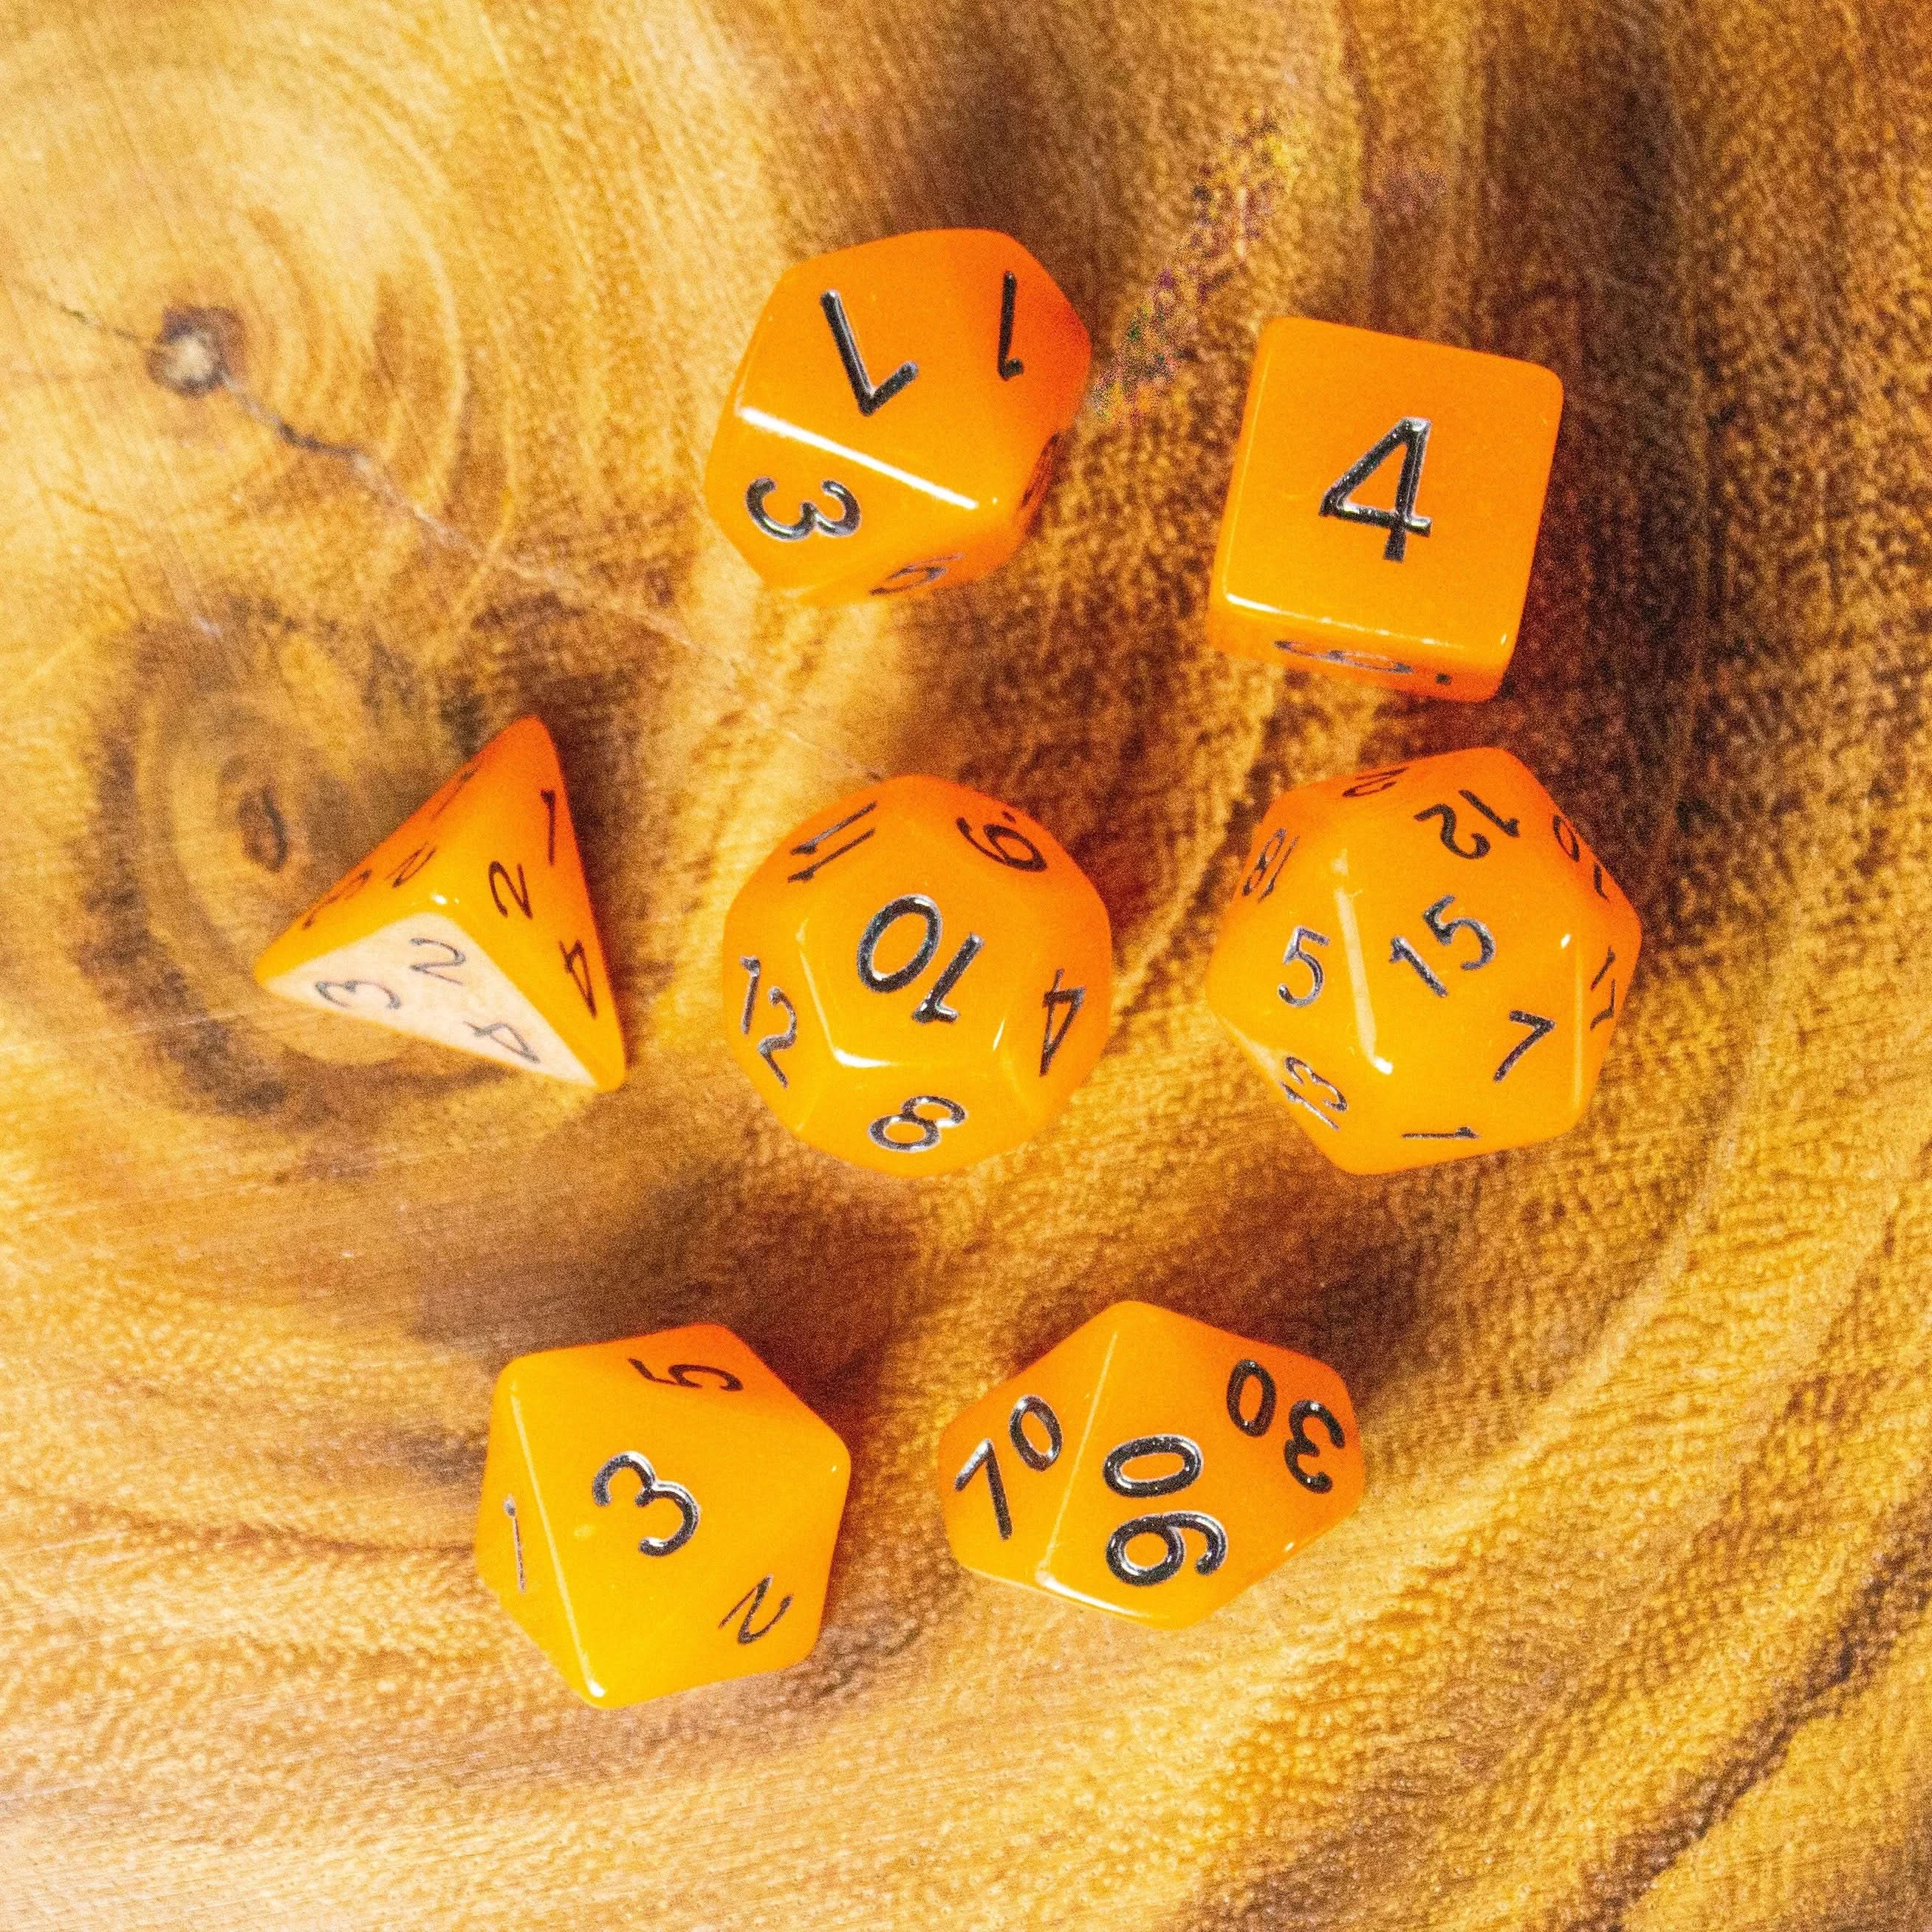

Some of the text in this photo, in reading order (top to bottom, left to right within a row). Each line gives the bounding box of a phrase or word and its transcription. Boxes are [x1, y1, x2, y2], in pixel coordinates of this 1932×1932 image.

[820, 289, 919, 417] 7
[998, 270, 1024, 381] 1
[744, 476, 860, 541] 3
[1319, 417, 1433, 563] 4
[540, 789, 557, 866] 1
[787, 801, 877, 883] 11
[1414, 788, 1521, 861] 12
[488, 860, 533, 921] 2
[409, 936, 467, 987] 2
[557, 939, 597, 1020] 4
[856, 892, 984, 1024] 10
[1278, 925, 1330, 1007] 5
[1388, 894, 1496, 998] 15
[314, 979, 402, 1012] 3
[739, 955, 799, 1089] 12
[1038, 967, 1086, 1078] 4
[462, 1020, 542, 1064] 4
[1493, 1010, 1555, 1084] 7
[866, 1095, 967, 1153] 8
[1278, 1055, 1348, 1131] 13
[627, 1357, 744, 1391] 5
[1226, 1358, 1347, 1494] 30
[592, 1450, 702, 1558] 3
[953, 1394, 1064, 1541] 70
[1102, 1433, 1230, 1587] 90
[718, 1573, 795, 1645] 2
